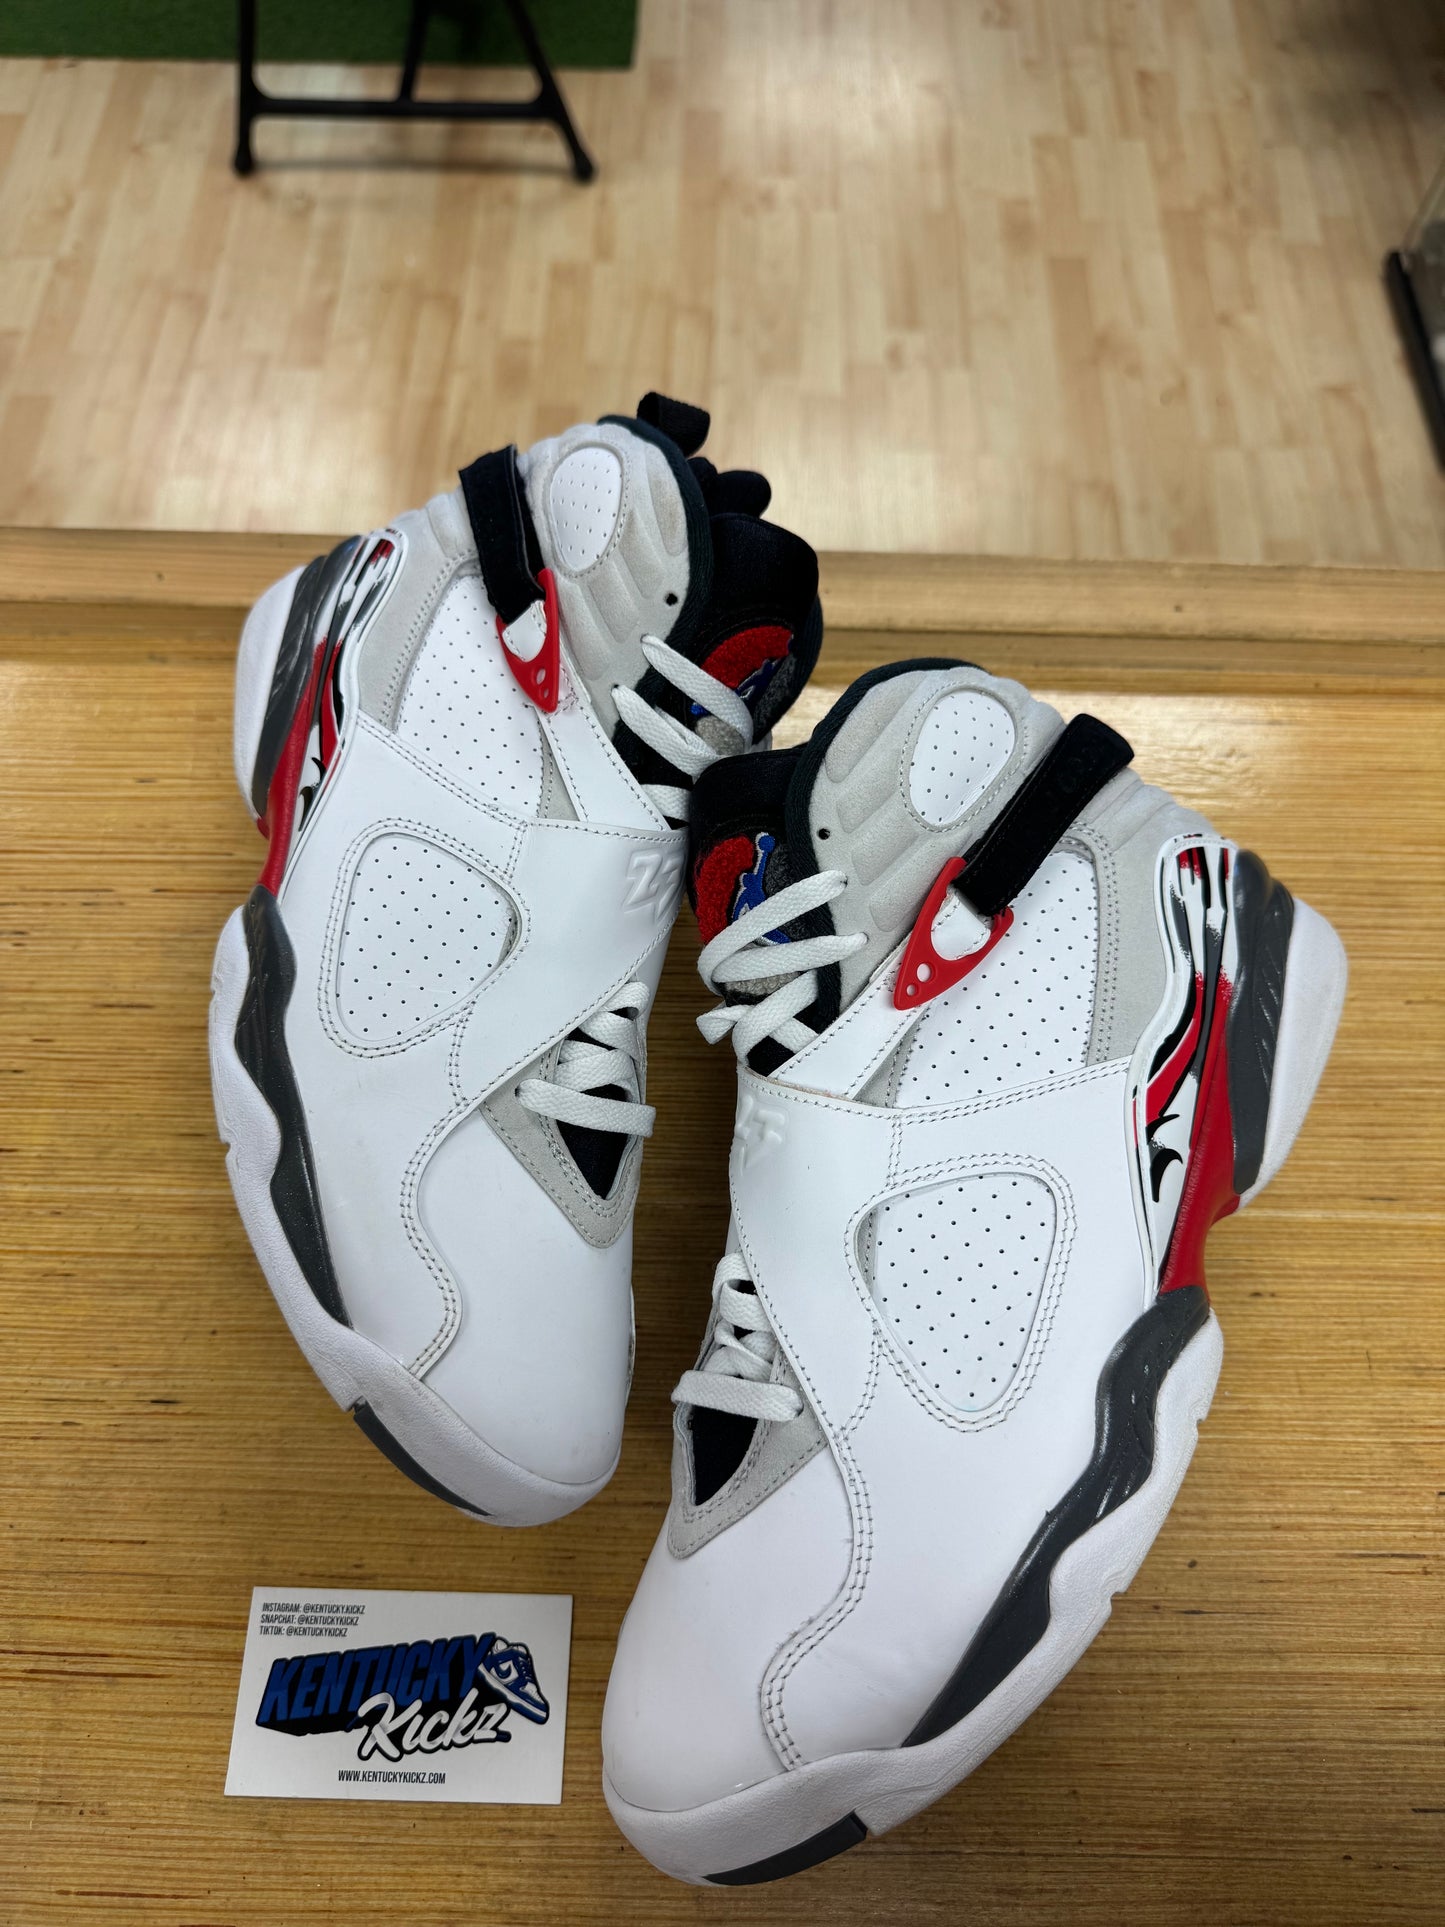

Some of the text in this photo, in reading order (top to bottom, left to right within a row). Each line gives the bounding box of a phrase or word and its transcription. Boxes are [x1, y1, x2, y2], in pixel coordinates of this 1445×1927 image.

[262, 1602, 301, 1613] INSTAGRAM:
[260, 1614, 360, 1626] SNAPCHAT: @KENTUCKYKICKZ
[259, 1626, 348, 1638] TIKTOK: @KENTUCKYKICKZ
[258, 1633, 496, 1730] KENTUCKY
[338, 1770, 446, 1784] WWW.KENTUCKYKICKZ.COM
